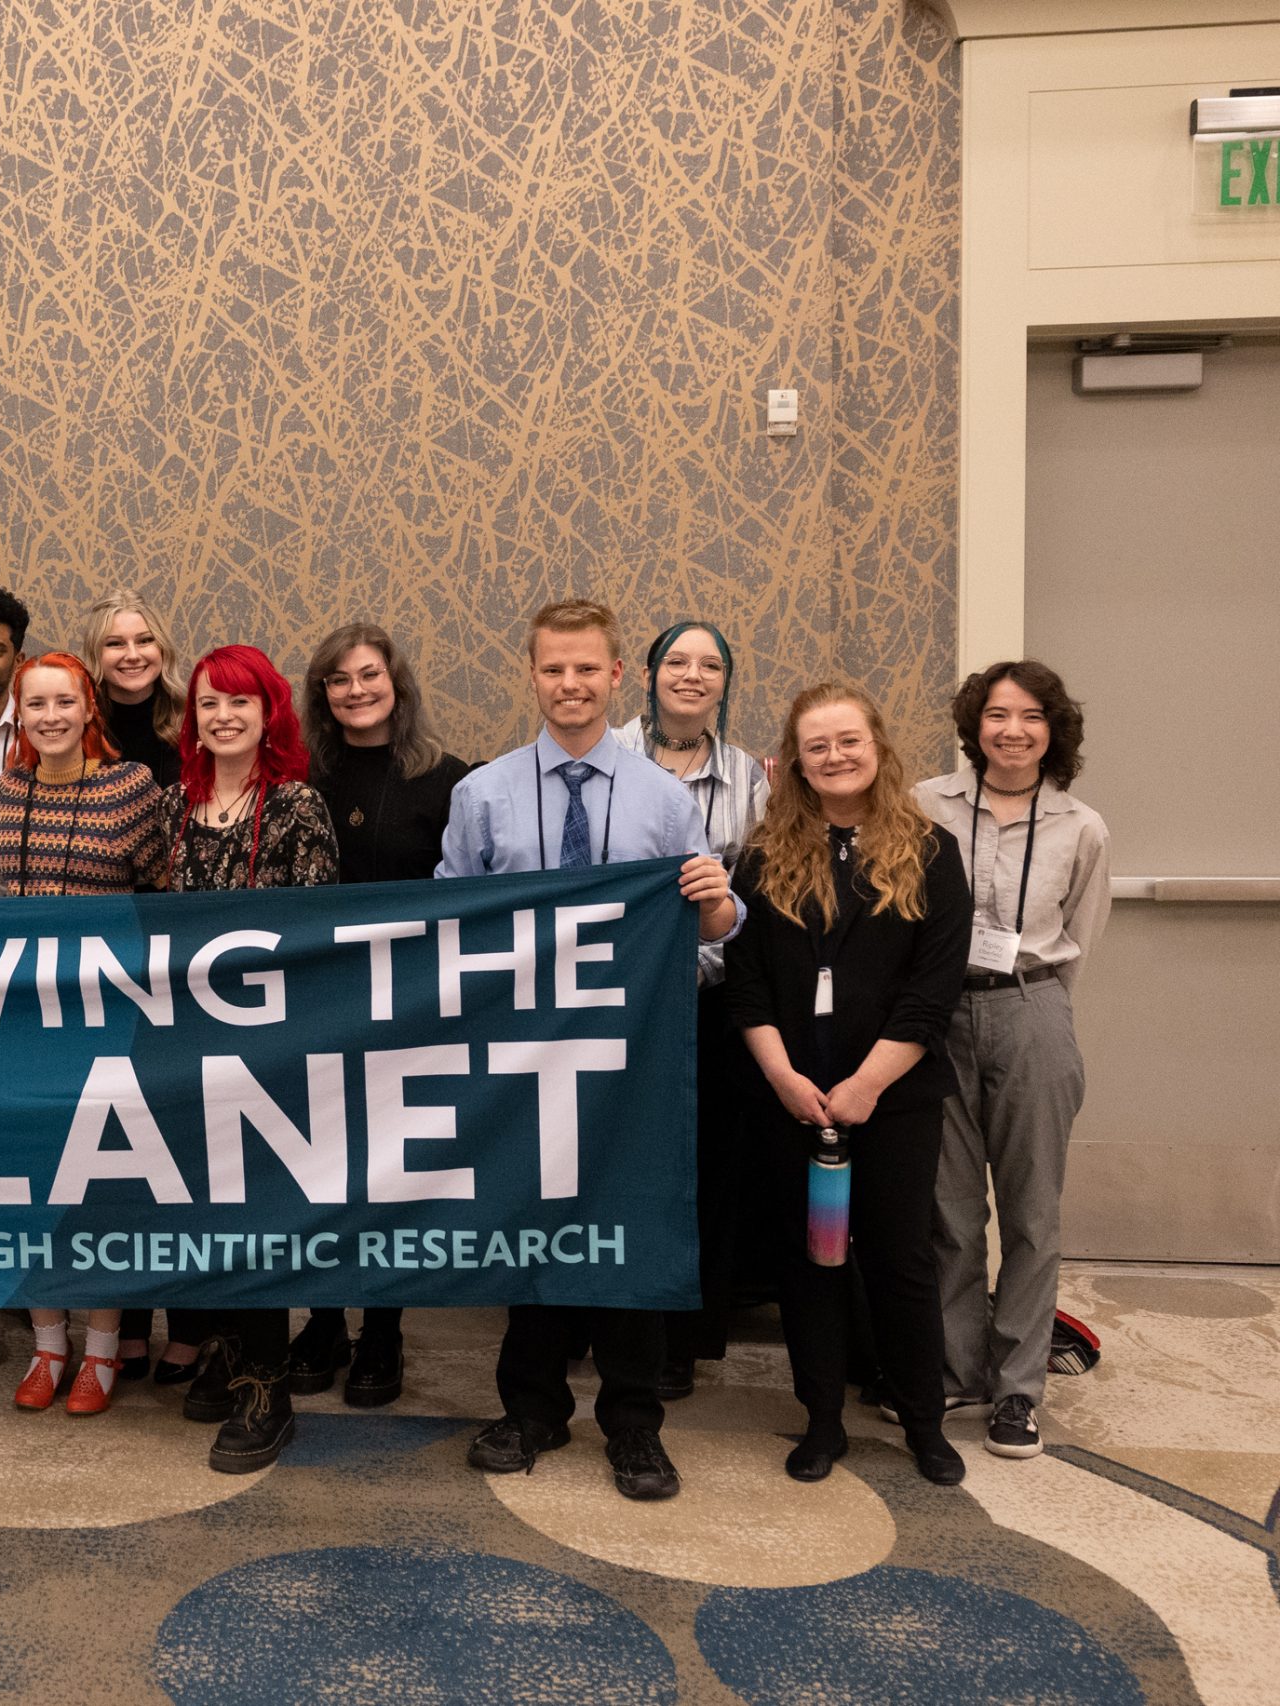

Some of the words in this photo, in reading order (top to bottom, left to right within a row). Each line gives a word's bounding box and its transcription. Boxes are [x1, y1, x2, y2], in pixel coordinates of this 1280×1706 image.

[333, 902, 626, 1021] THE
[71, 1231, 340, 1272] SCIENTIFIC
[358, 1224, 625, 1269] RESEARCH
